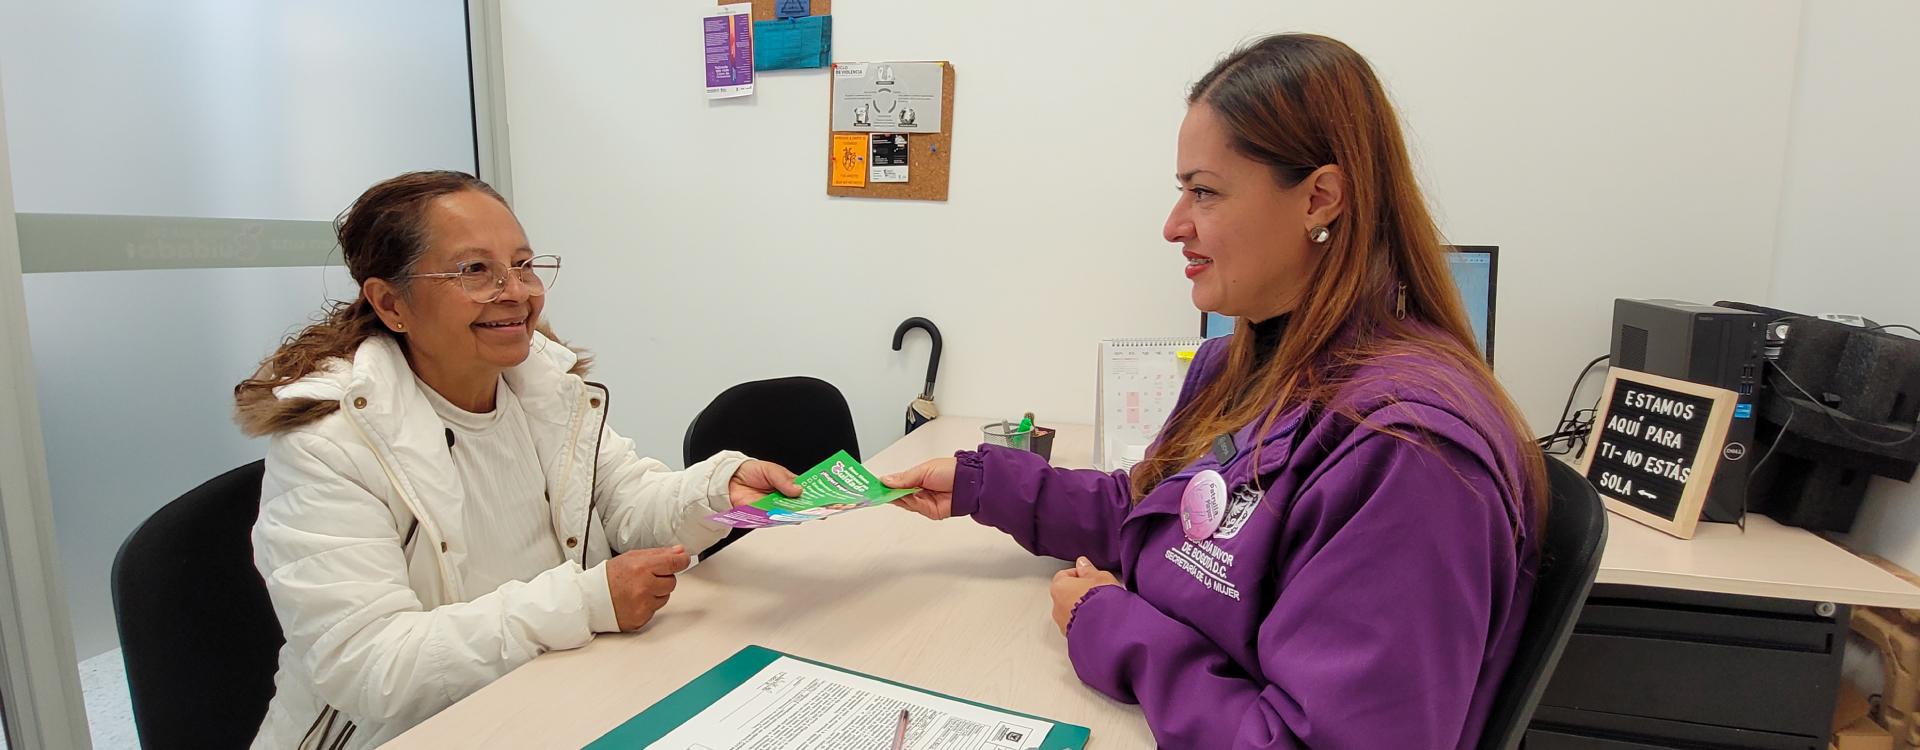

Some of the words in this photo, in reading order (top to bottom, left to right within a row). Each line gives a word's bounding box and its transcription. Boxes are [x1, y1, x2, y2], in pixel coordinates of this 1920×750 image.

[1625, 390, 1695, 420] ESTAMOS
[1607, 415, 1645, 437] AQUÍ
[1644, 425, 1682, 449] PARA
[1600, 471, 1632, 496] SOLA
[1644, 457, 1691, 484] ESTÁS
[1181, 541, 1194, 555] DE
[1190, 547, 1214, 571] BOGOTÁ
[1212, 561, 1227, 579] D.C.
[1211, 545, 1234, 567] MAYOR
[1165, 549, 1198, 577] SECRETARÍA
[1195, 570, 1205, 583] DE
[1203, 575, 1212, 589] LA
[1213, 580, 1240, 601] MUJER
